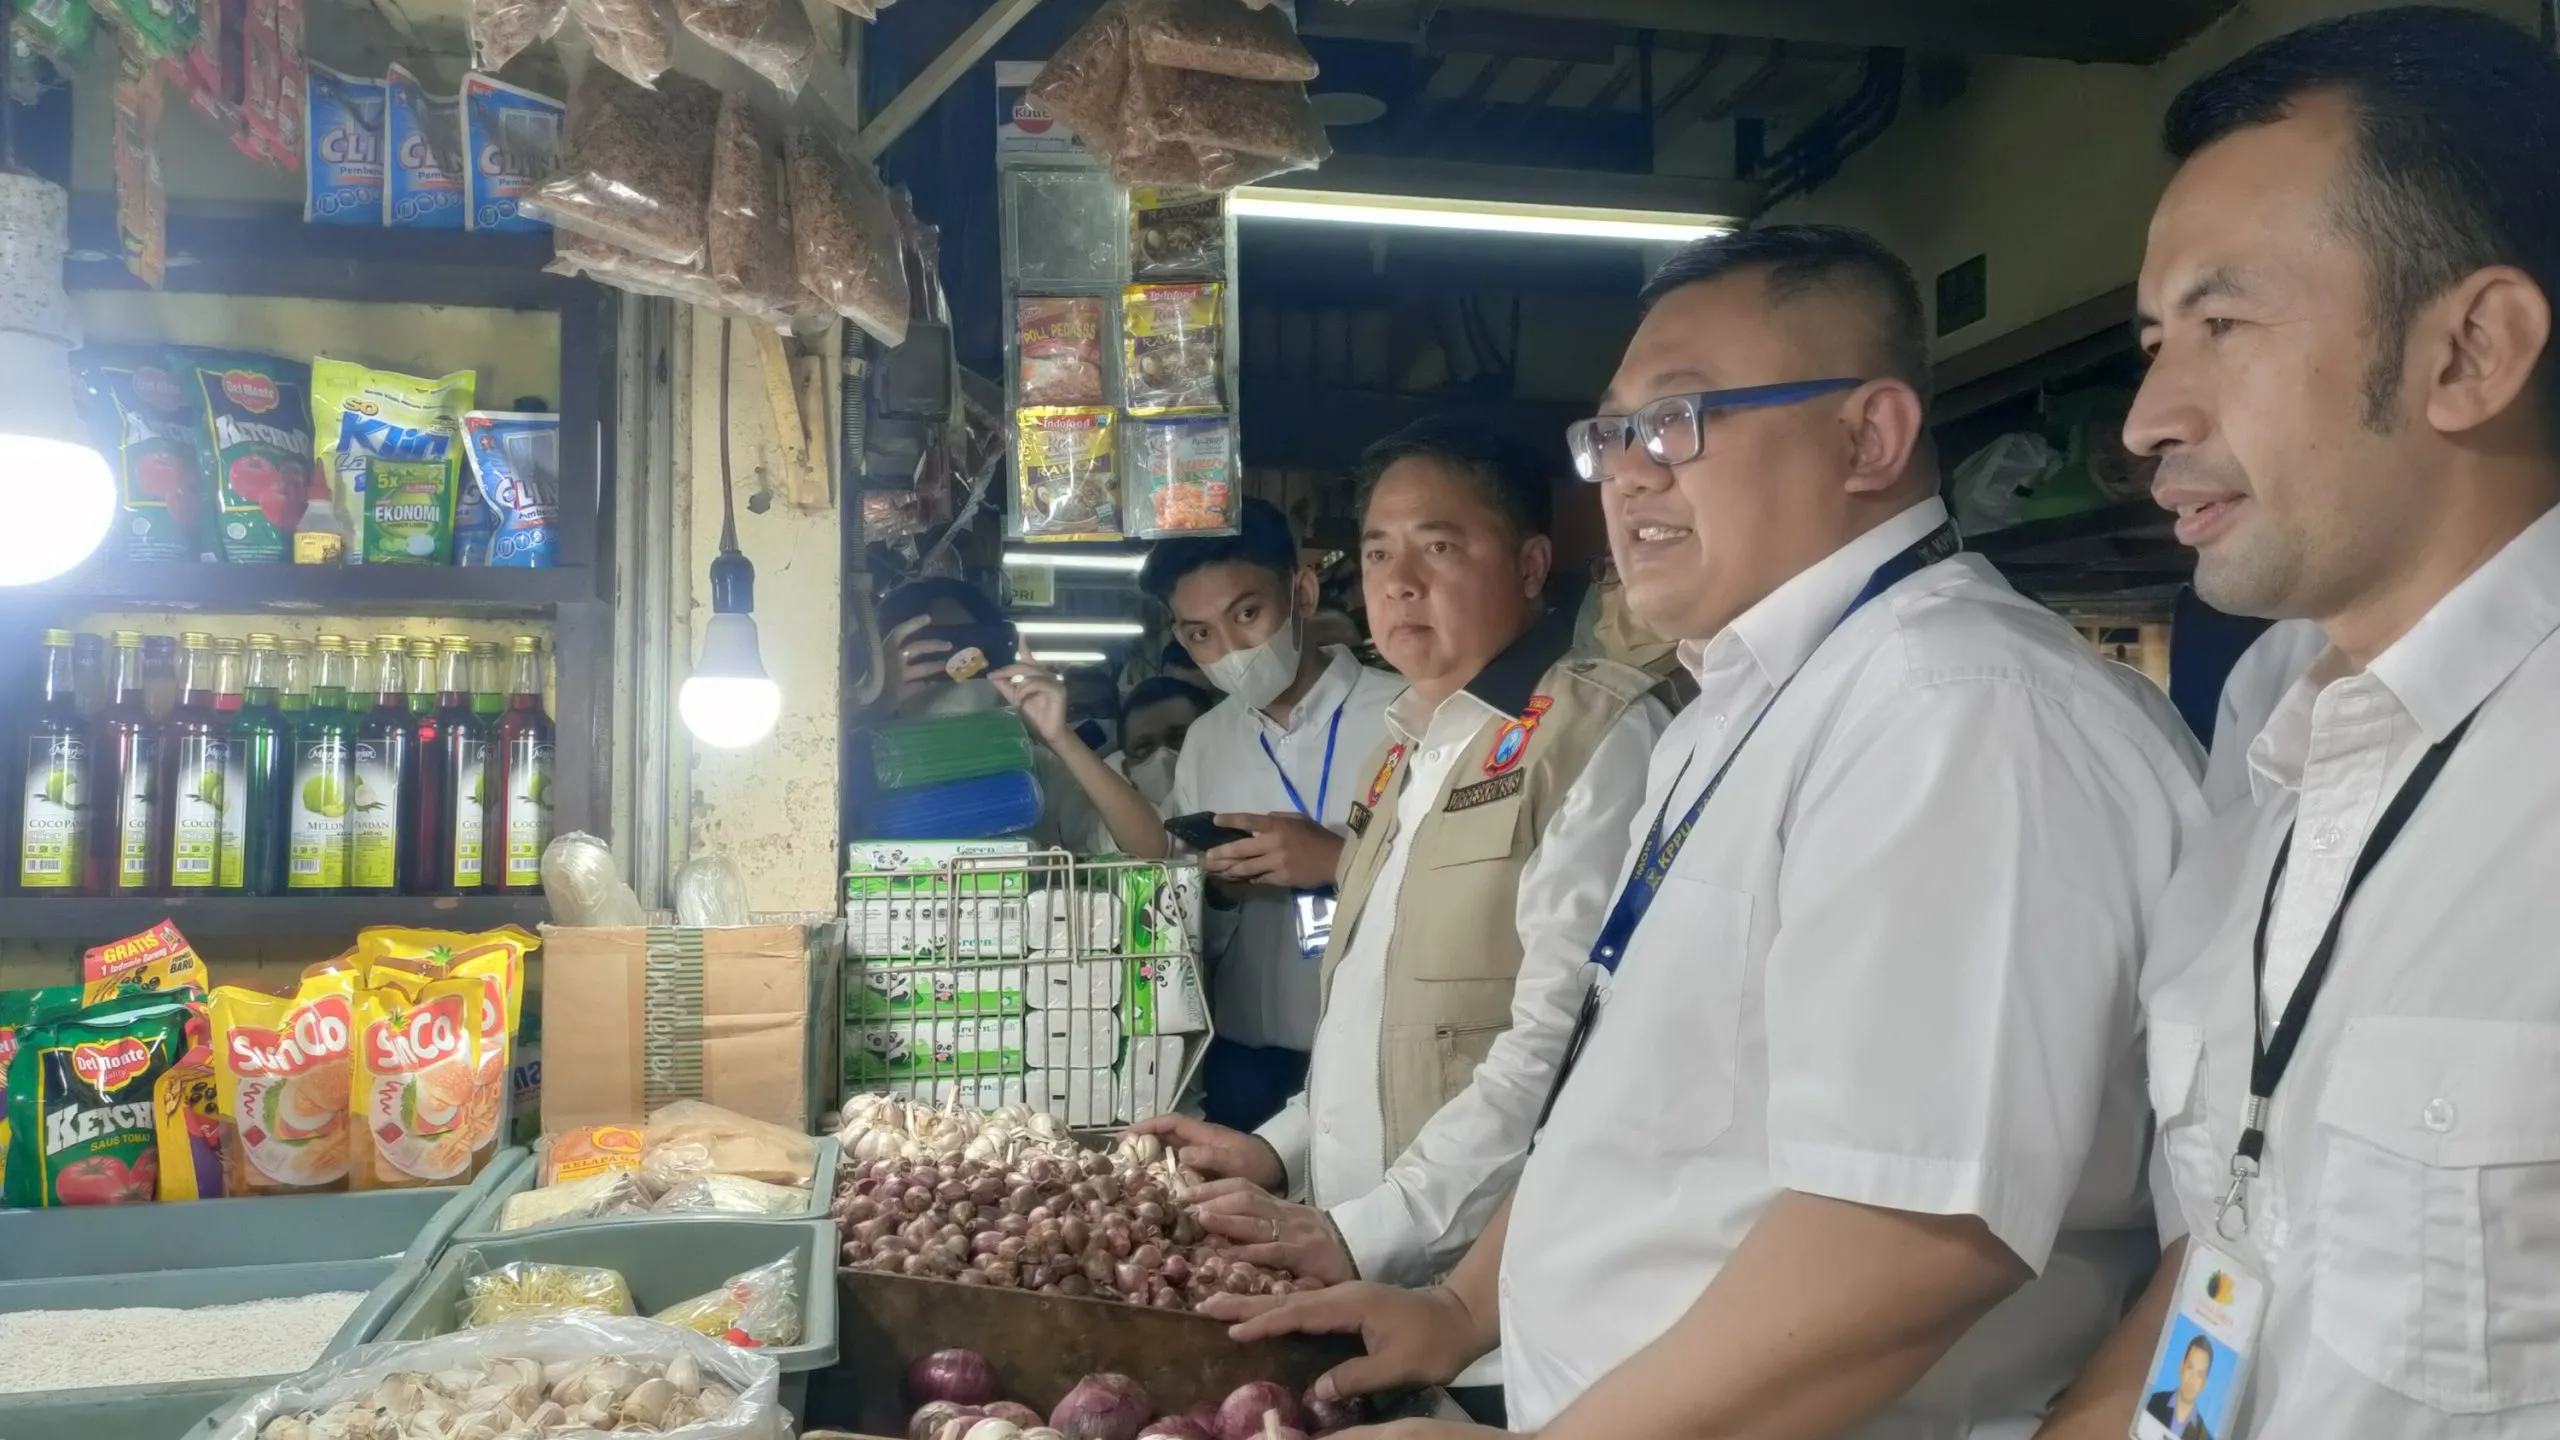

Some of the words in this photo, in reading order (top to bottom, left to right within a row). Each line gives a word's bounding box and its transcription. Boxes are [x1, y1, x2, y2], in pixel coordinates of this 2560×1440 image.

[321, 128, 384, 164] CLI
[1150, 290, 1197, 301] Indofood
[1043, 416, 1091, 428] Indofood
[374, 504, 440, 522] EKONOMI
[1658, 821, 1692, 870] KPPU
[103, 933, 159, 964] GRATIS
[101, 965, 107, 976] 1
[170, 958, 194, 974] BARU
[233, 1010, 347, 1071] SunCo
[76, 1055, 98, 1071] Del
[46, 1101, 154, 1156] KETCH
[90, 1135, 121, 1152] SAUS
